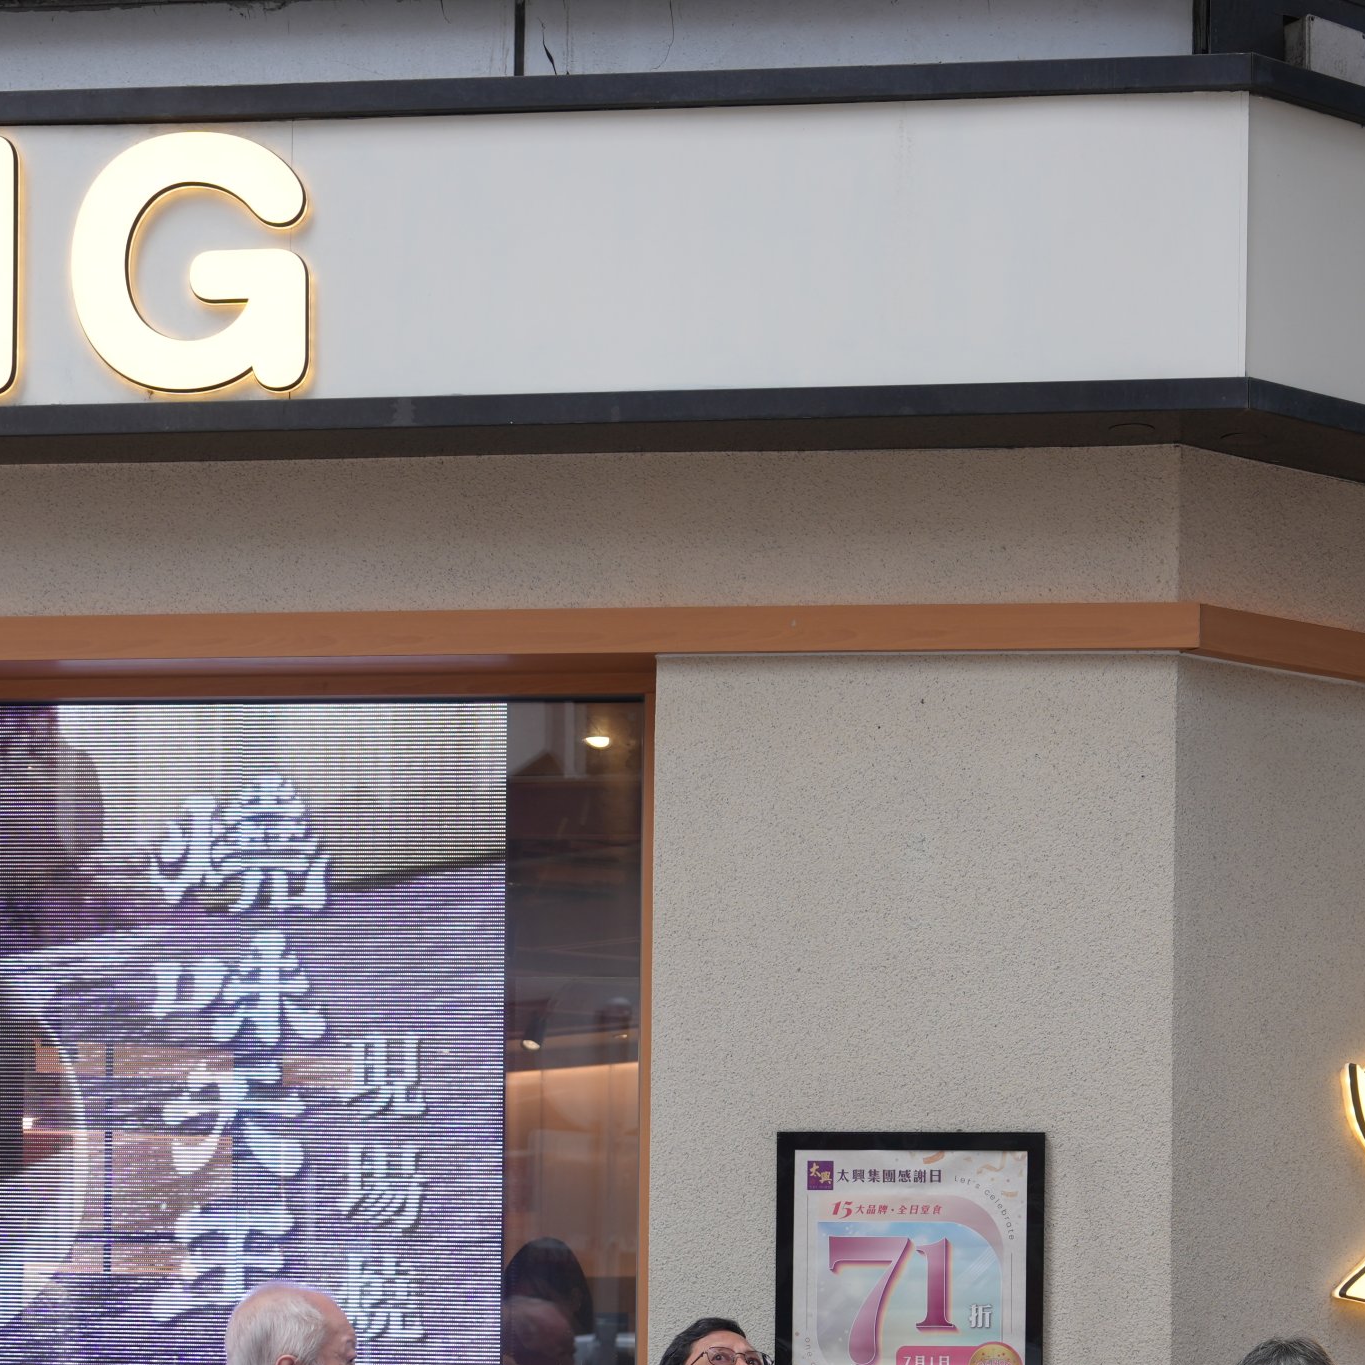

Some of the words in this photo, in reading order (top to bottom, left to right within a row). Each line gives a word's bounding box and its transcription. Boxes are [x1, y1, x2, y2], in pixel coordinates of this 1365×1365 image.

[837, 1168, 943, 1184] 太興集團感謝日
[969, 1304, 993, 1329] 折
